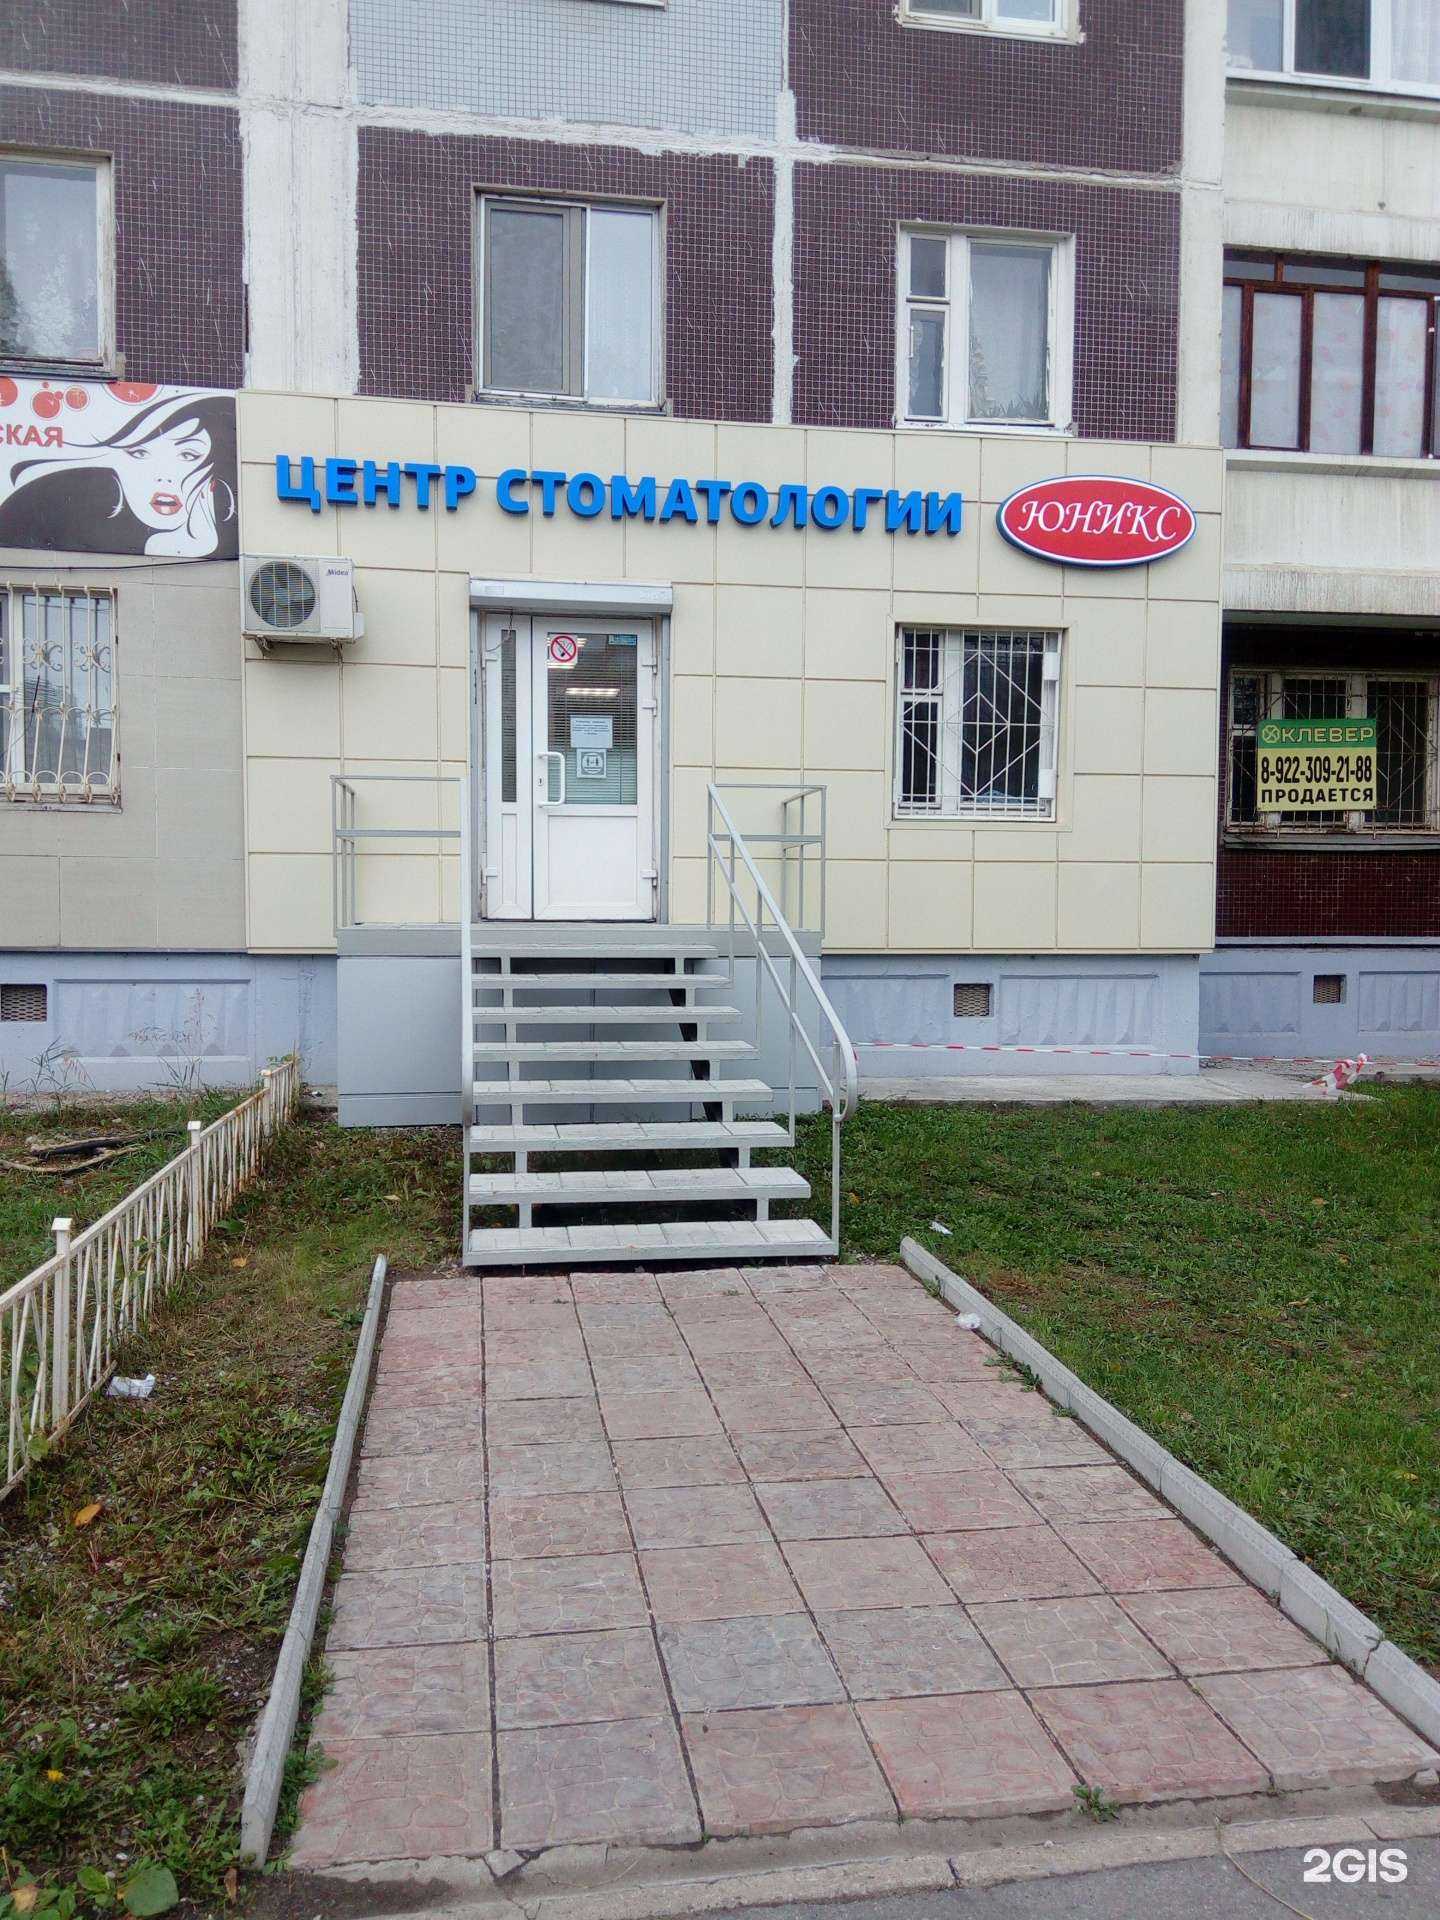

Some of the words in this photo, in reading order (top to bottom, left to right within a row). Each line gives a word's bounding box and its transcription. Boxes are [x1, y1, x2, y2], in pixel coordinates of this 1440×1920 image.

[0, 423, 63, 448] КАЯ
[275, 454, 477, 513] ЦЕНТР
[496, 468, 963, 536] СТОМАТОЛОГИИ
[1018, 499, 1183, 542] ЮНИКС
[1282, 727, 1374, 743] КЛЕВЕР
[1261, 755, 1372, 784] 8-922-309-21-88
[1261, 788, 1374, 804] ПРОДАЕТСЯ
